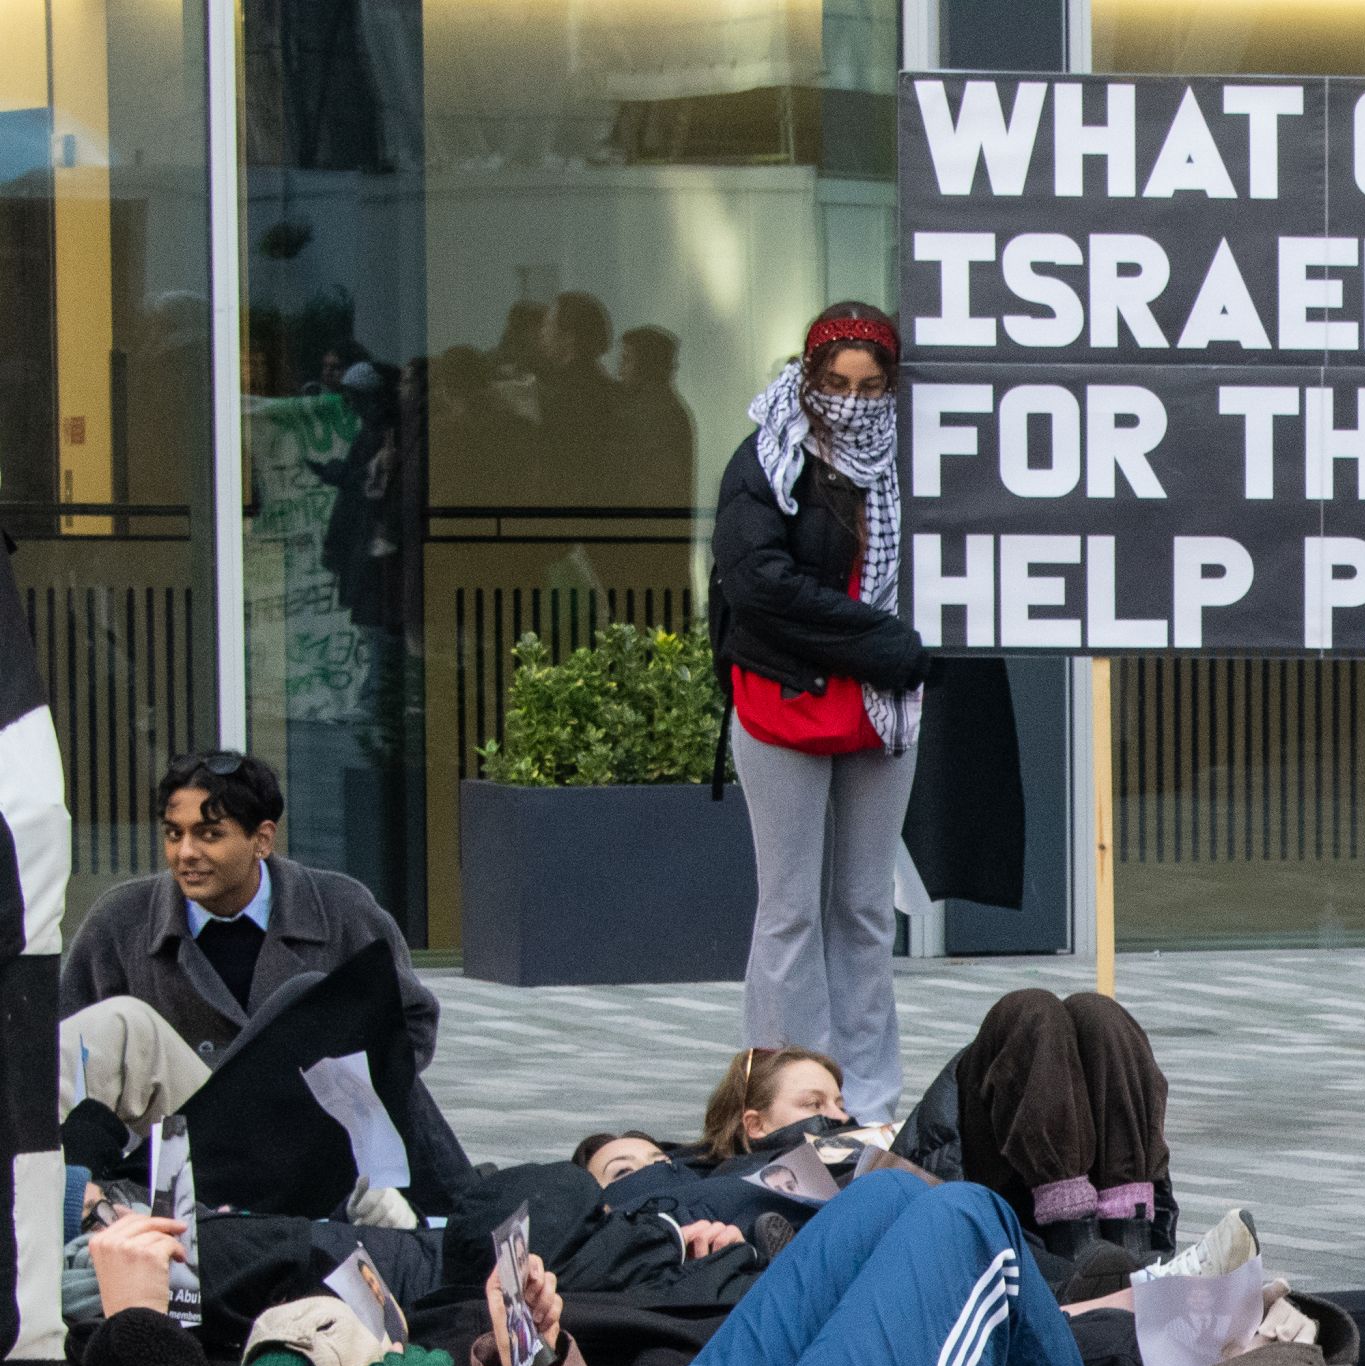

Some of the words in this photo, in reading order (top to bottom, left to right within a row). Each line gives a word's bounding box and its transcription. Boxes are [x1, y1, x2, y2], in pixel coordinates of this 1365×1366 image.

[914, 80, 1304, 199] WHAT
[912, 384, 1168, 499] FOR
[912, 534, 1254, 648] HELP
